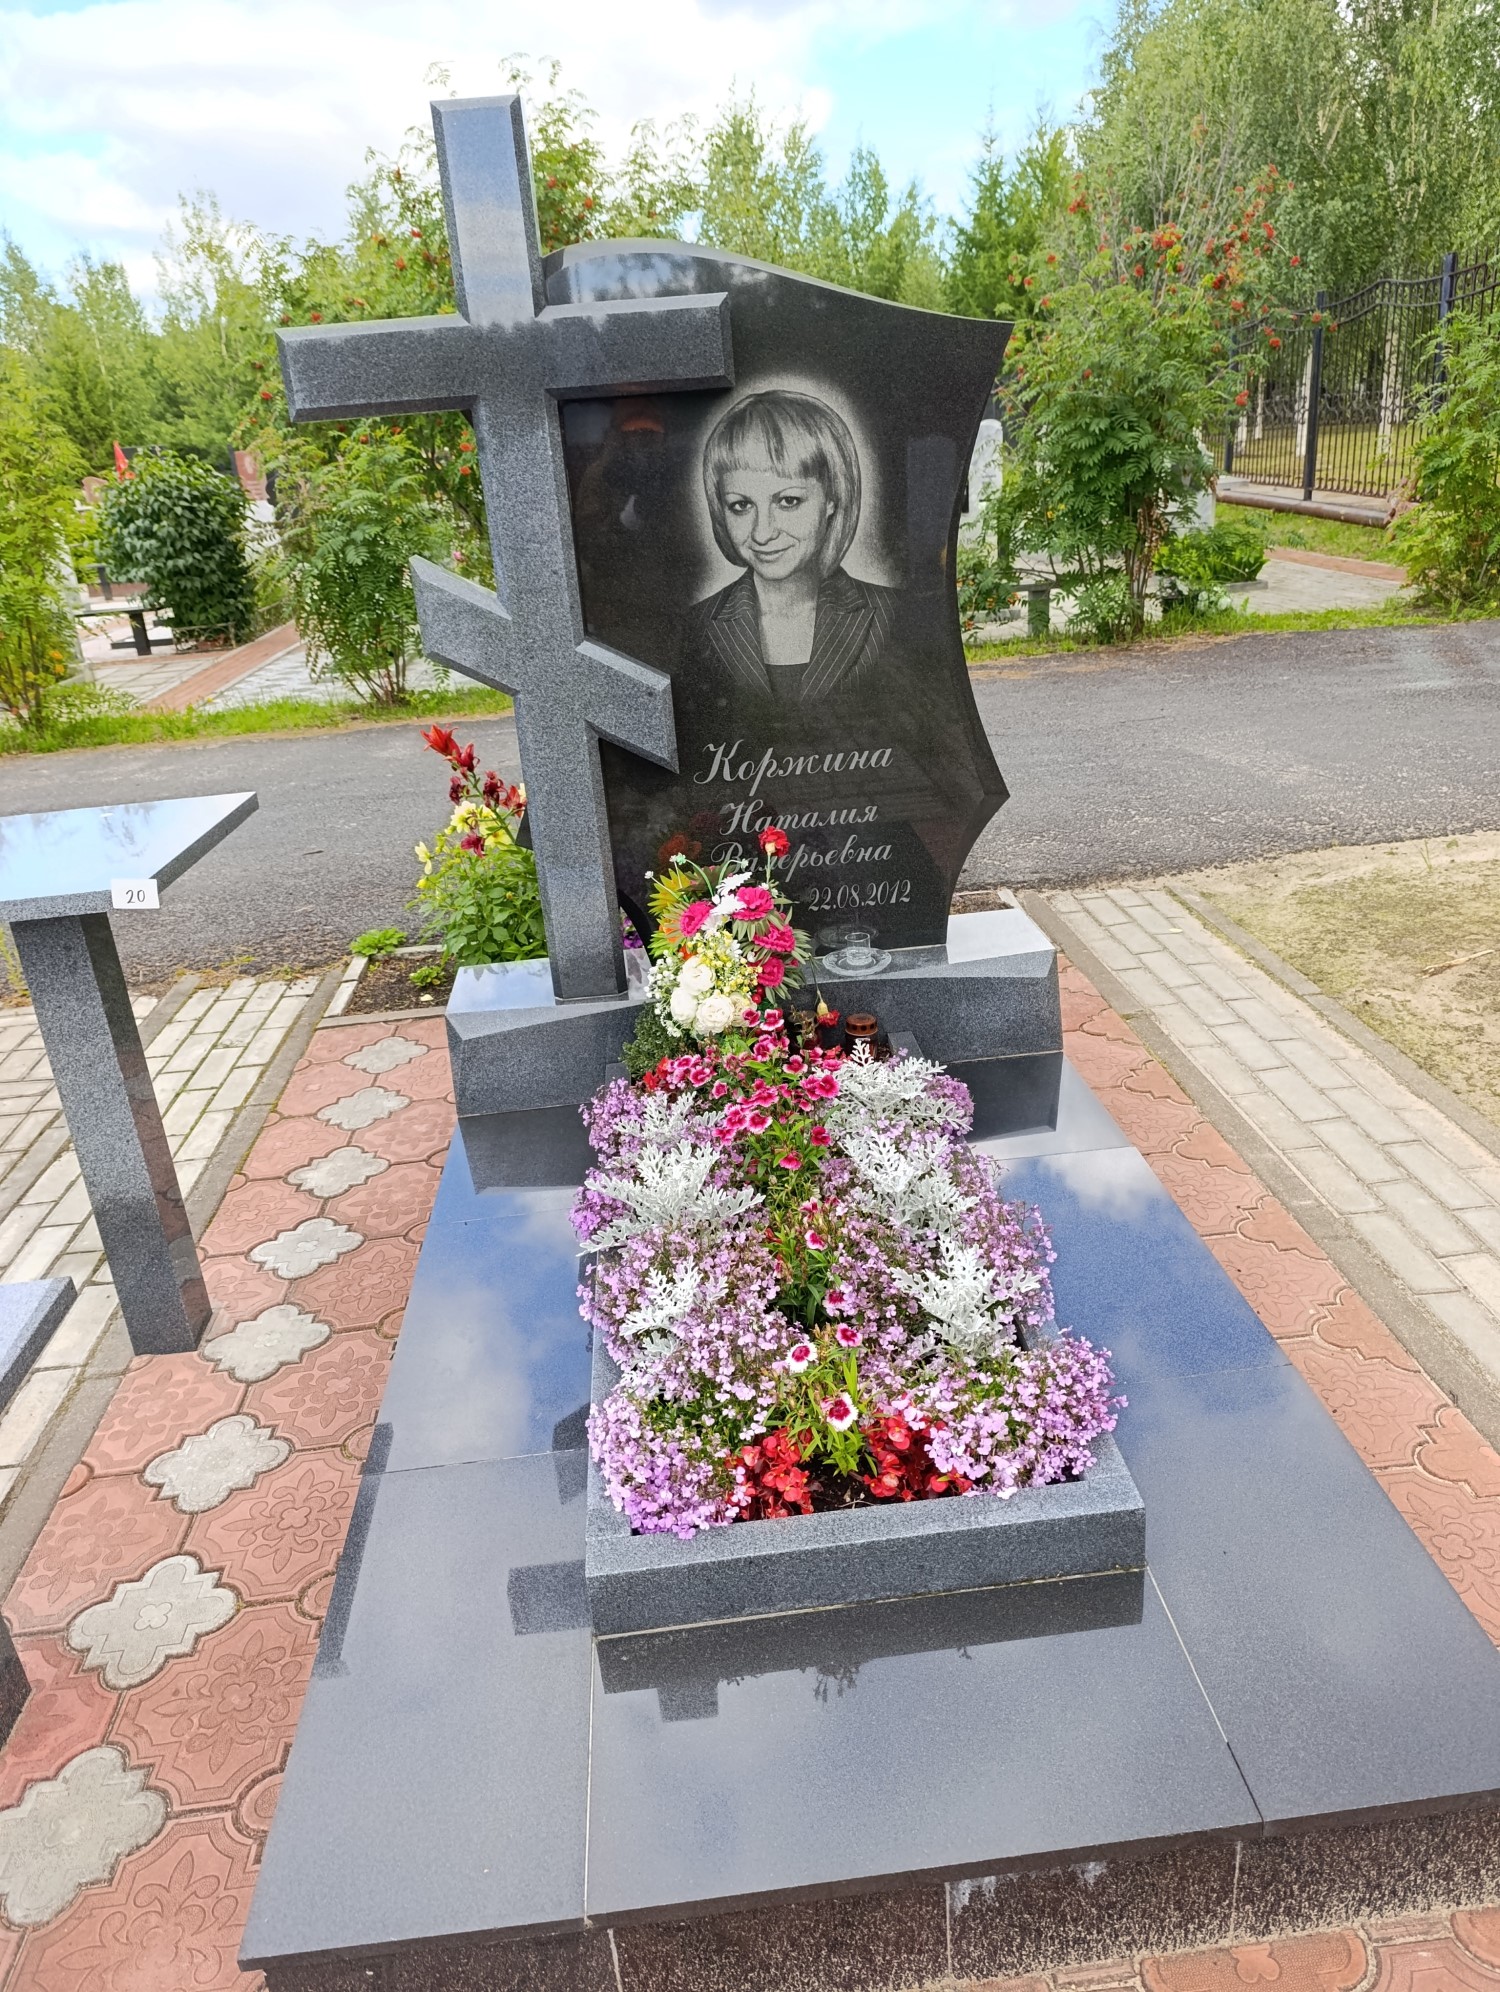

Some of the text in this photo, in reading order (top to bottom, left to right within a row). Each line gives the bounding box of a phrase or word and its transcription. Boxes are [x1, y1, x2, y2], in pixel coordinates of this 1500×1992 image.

[693, 739, 893, 796] Коржина
[719, 799, 878, 836] Наталия
[125, 889, 146, 904] 20
[808, 879, 911, 912] 22.08.2012
